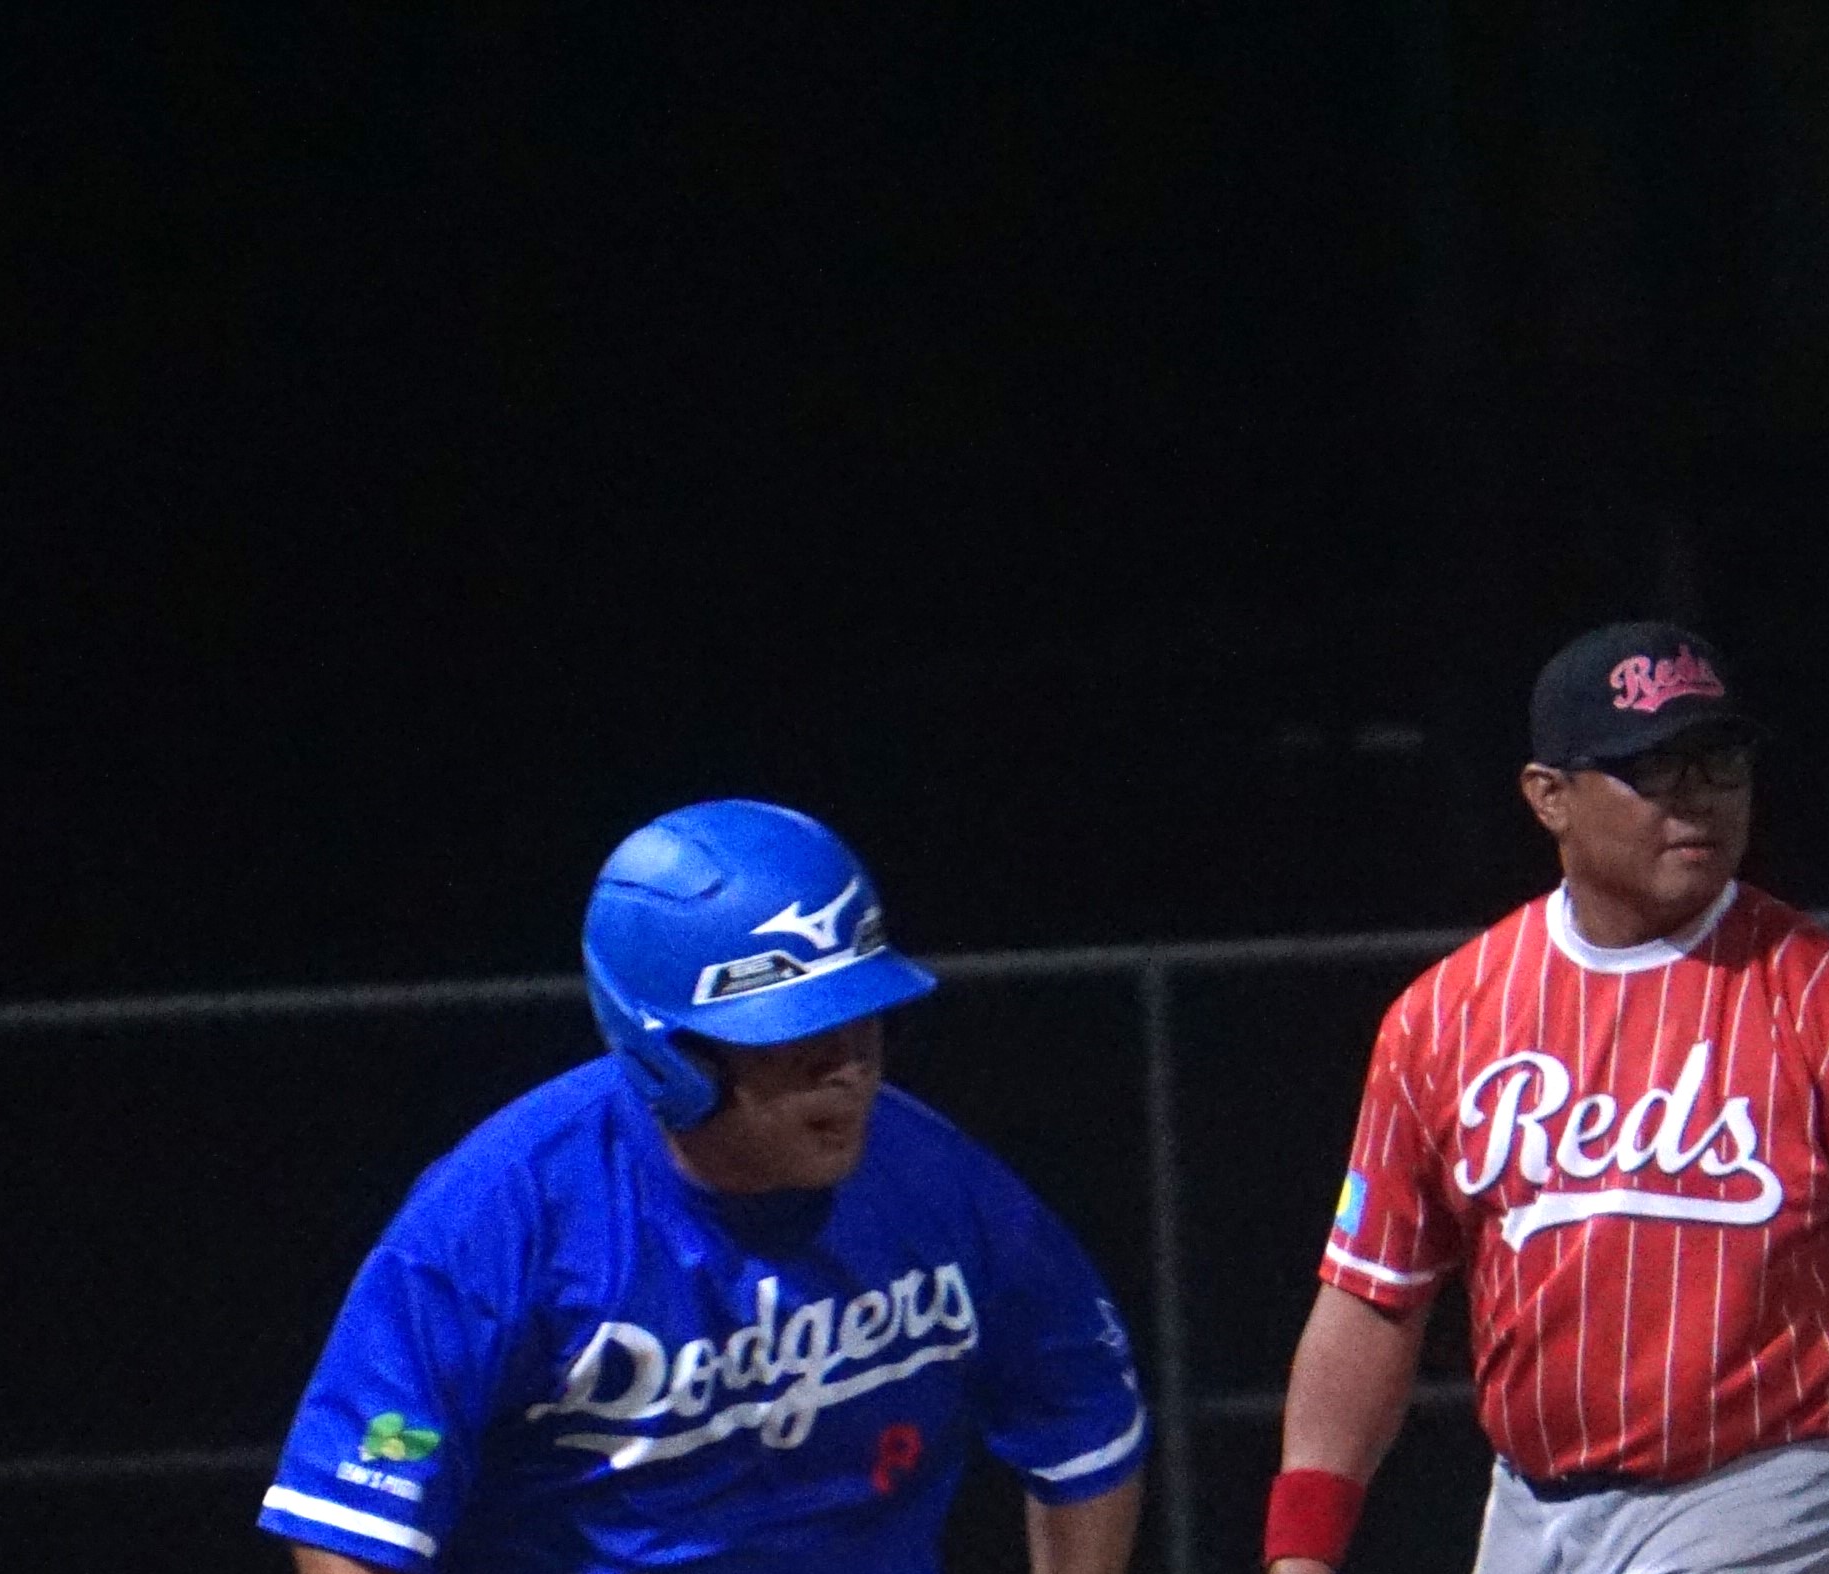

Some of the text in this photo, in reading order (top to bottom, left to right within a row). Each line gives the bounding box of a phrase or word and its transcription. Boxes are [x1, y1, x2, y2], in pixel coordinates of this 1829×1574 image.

[1609, 643, 1724, 712] Reds
[1454, 1040, 1785, 1252] Reds
[528, 1262, 979, 1471] Dodgers
